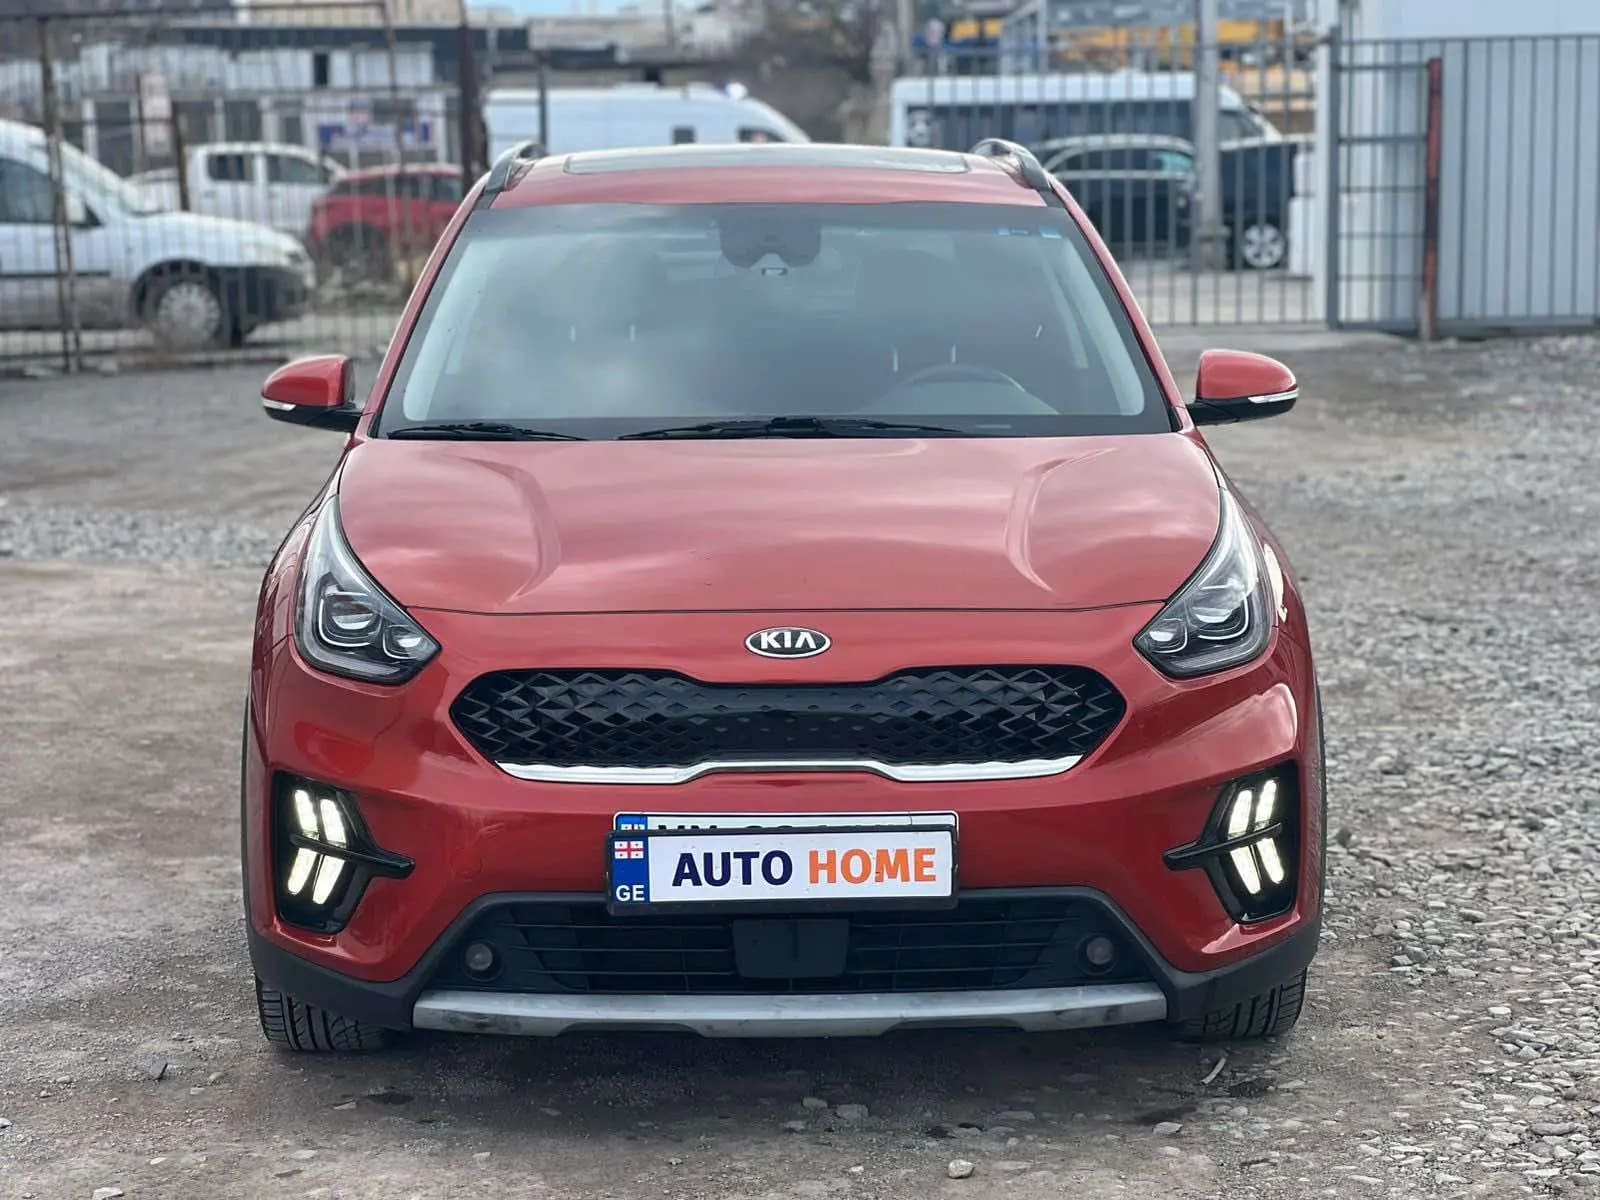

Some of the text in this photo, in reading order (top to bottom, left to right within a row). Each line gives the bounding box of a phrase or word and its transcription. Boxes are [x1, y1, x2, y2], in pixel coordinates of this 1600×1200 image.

[760, 631, 817, 649] KIA
[672, 847, 936, 887] AUTO HOME
[616, 885, 645, 902] GE
